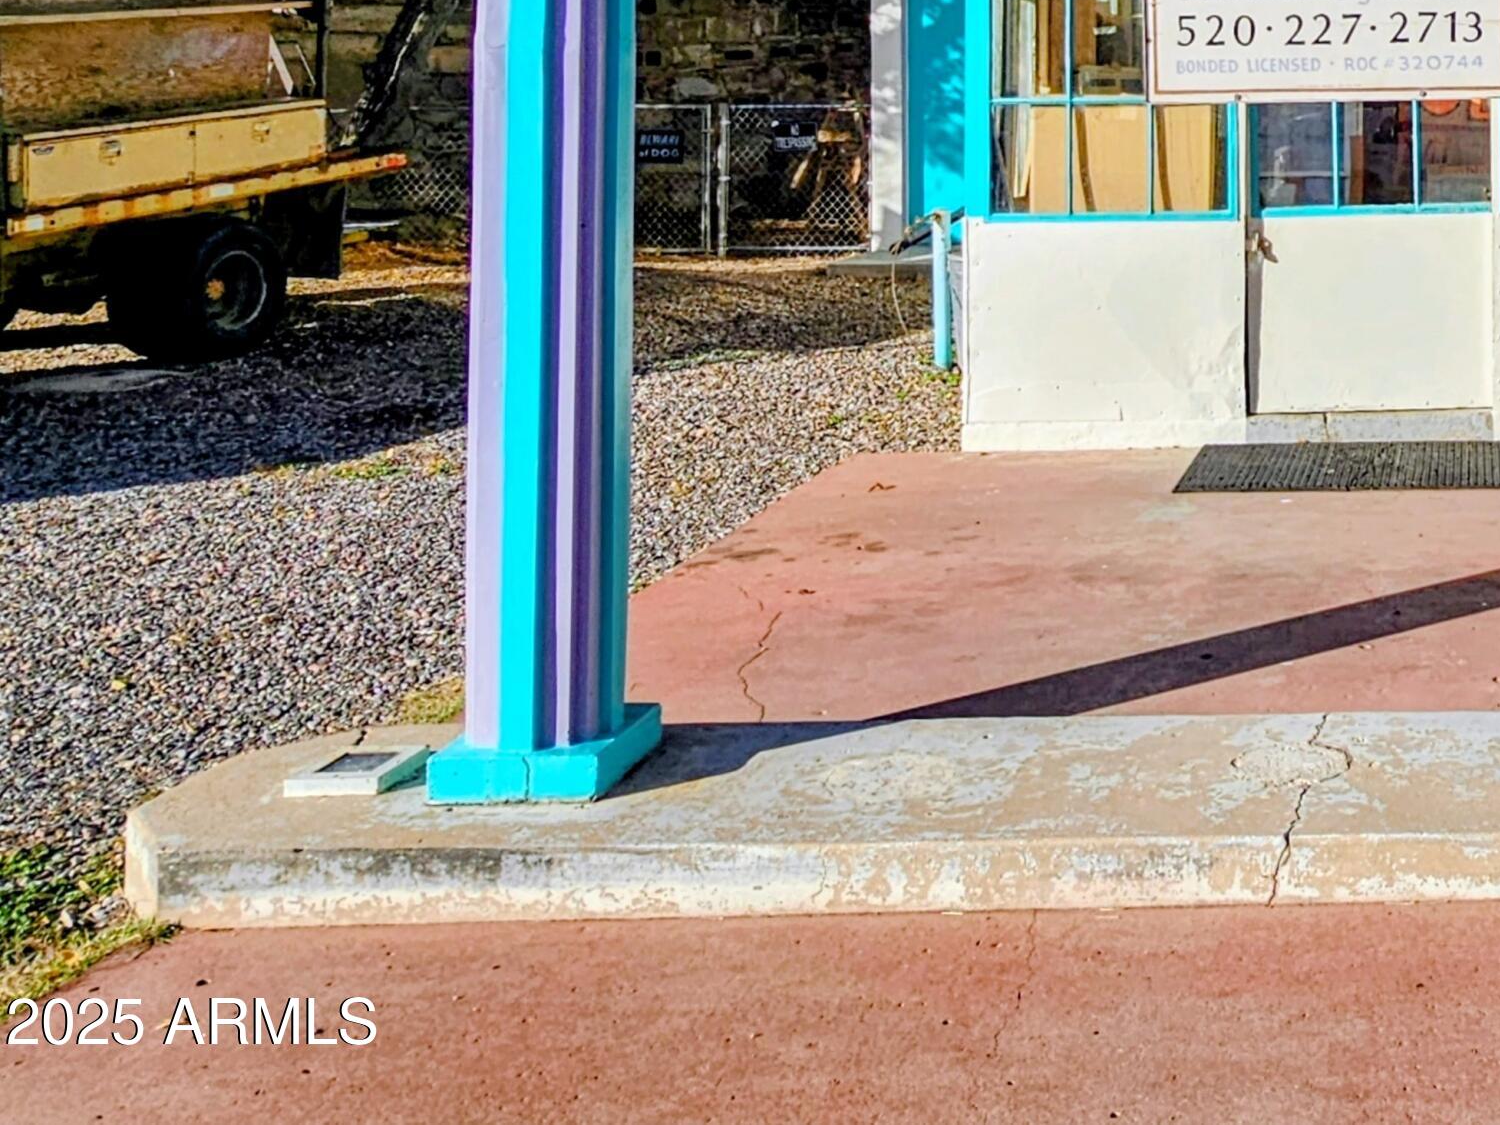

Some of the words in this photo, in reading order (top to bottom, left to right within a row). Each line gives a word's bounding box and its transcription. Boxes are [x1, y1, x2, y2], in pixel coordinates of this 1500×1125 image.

[1176, 59, 1239, 74] BONDED
[1247, 57, 1322, 73] LICENSED
[1344, 56, 1379, 72] ROC
[651, 148, 680, 158] DOG
